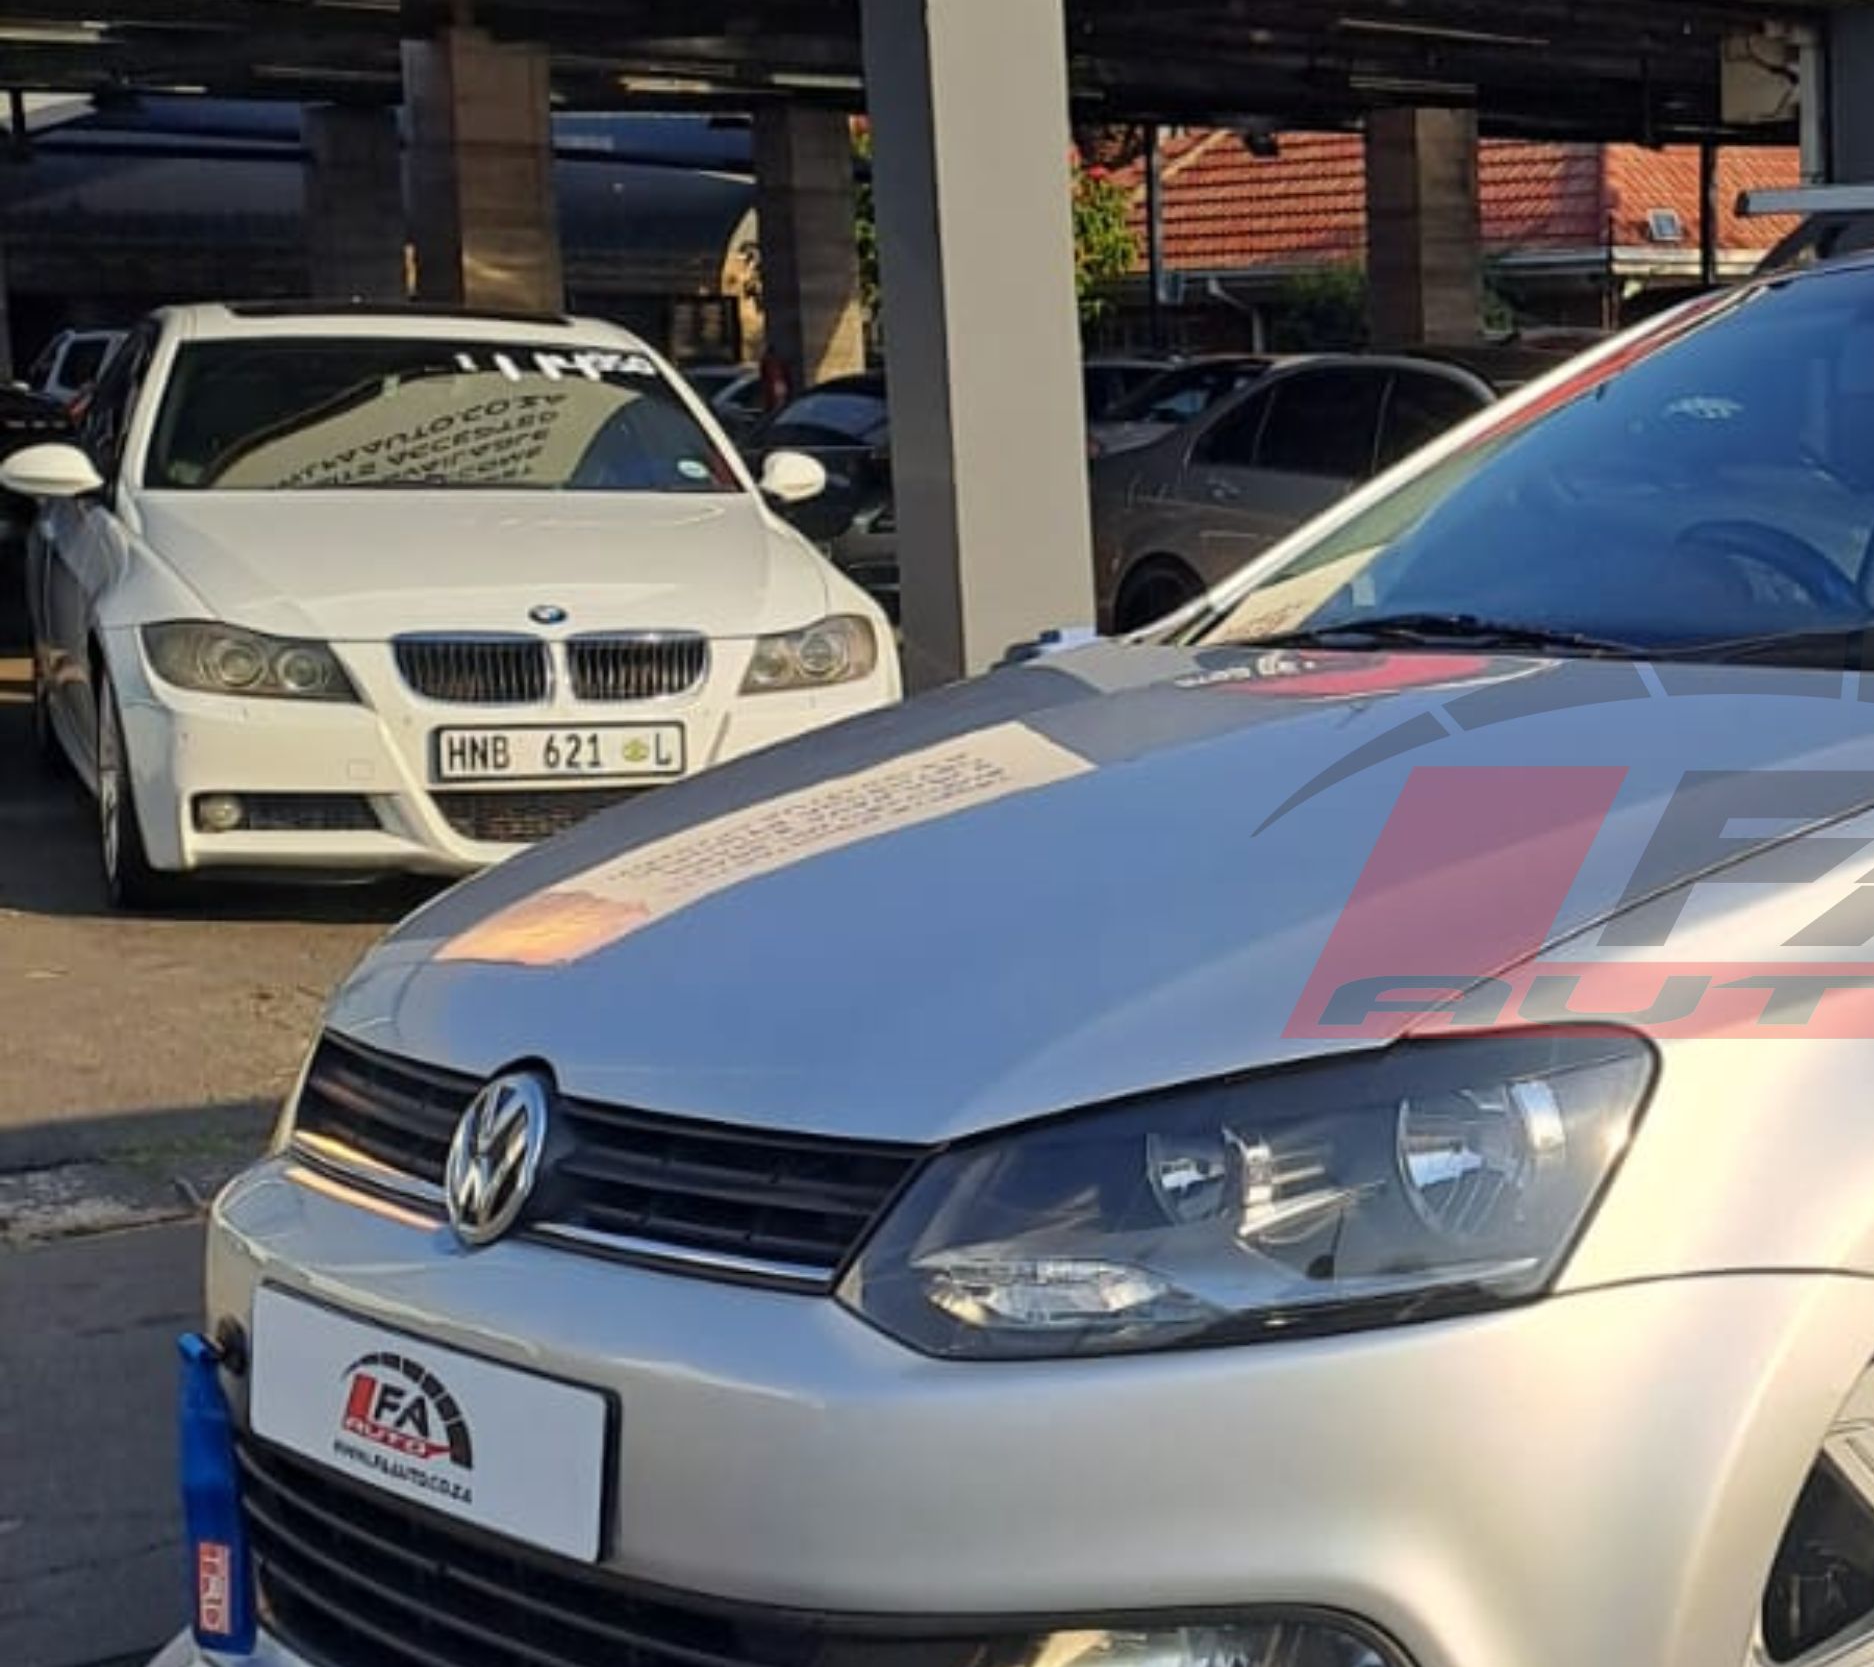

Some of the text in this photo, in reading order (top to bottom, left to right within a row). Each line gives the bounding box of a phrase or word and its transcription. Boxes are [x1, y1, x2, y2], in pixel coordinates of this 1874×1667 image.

[447, 732, 673, 772] HNB 621 L
